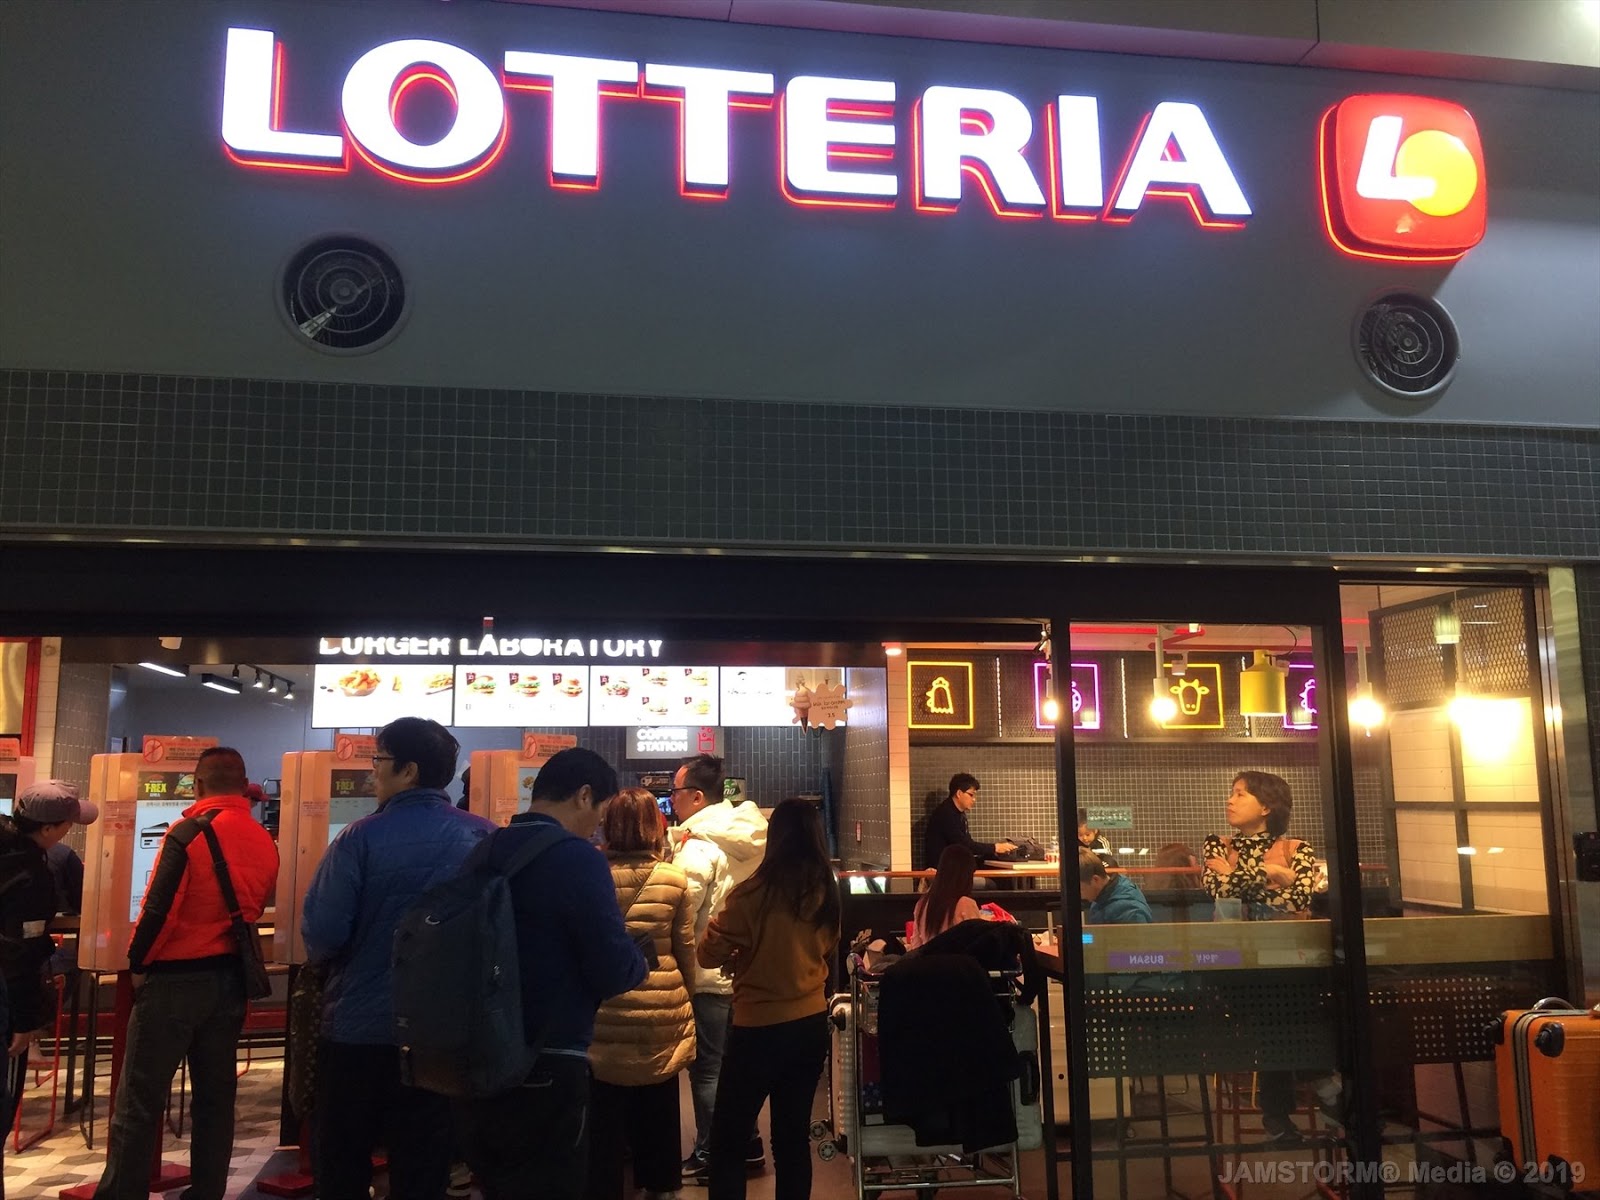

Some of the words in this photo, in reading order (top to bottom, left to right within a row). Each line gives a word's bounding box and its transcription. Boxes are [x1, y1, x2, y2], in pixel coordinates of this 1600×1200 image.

[220, 27, 1252, 220] LOTTERIA
[637, 741, 688, 752] STATION
[144, 783, 167, 793] T-REX
